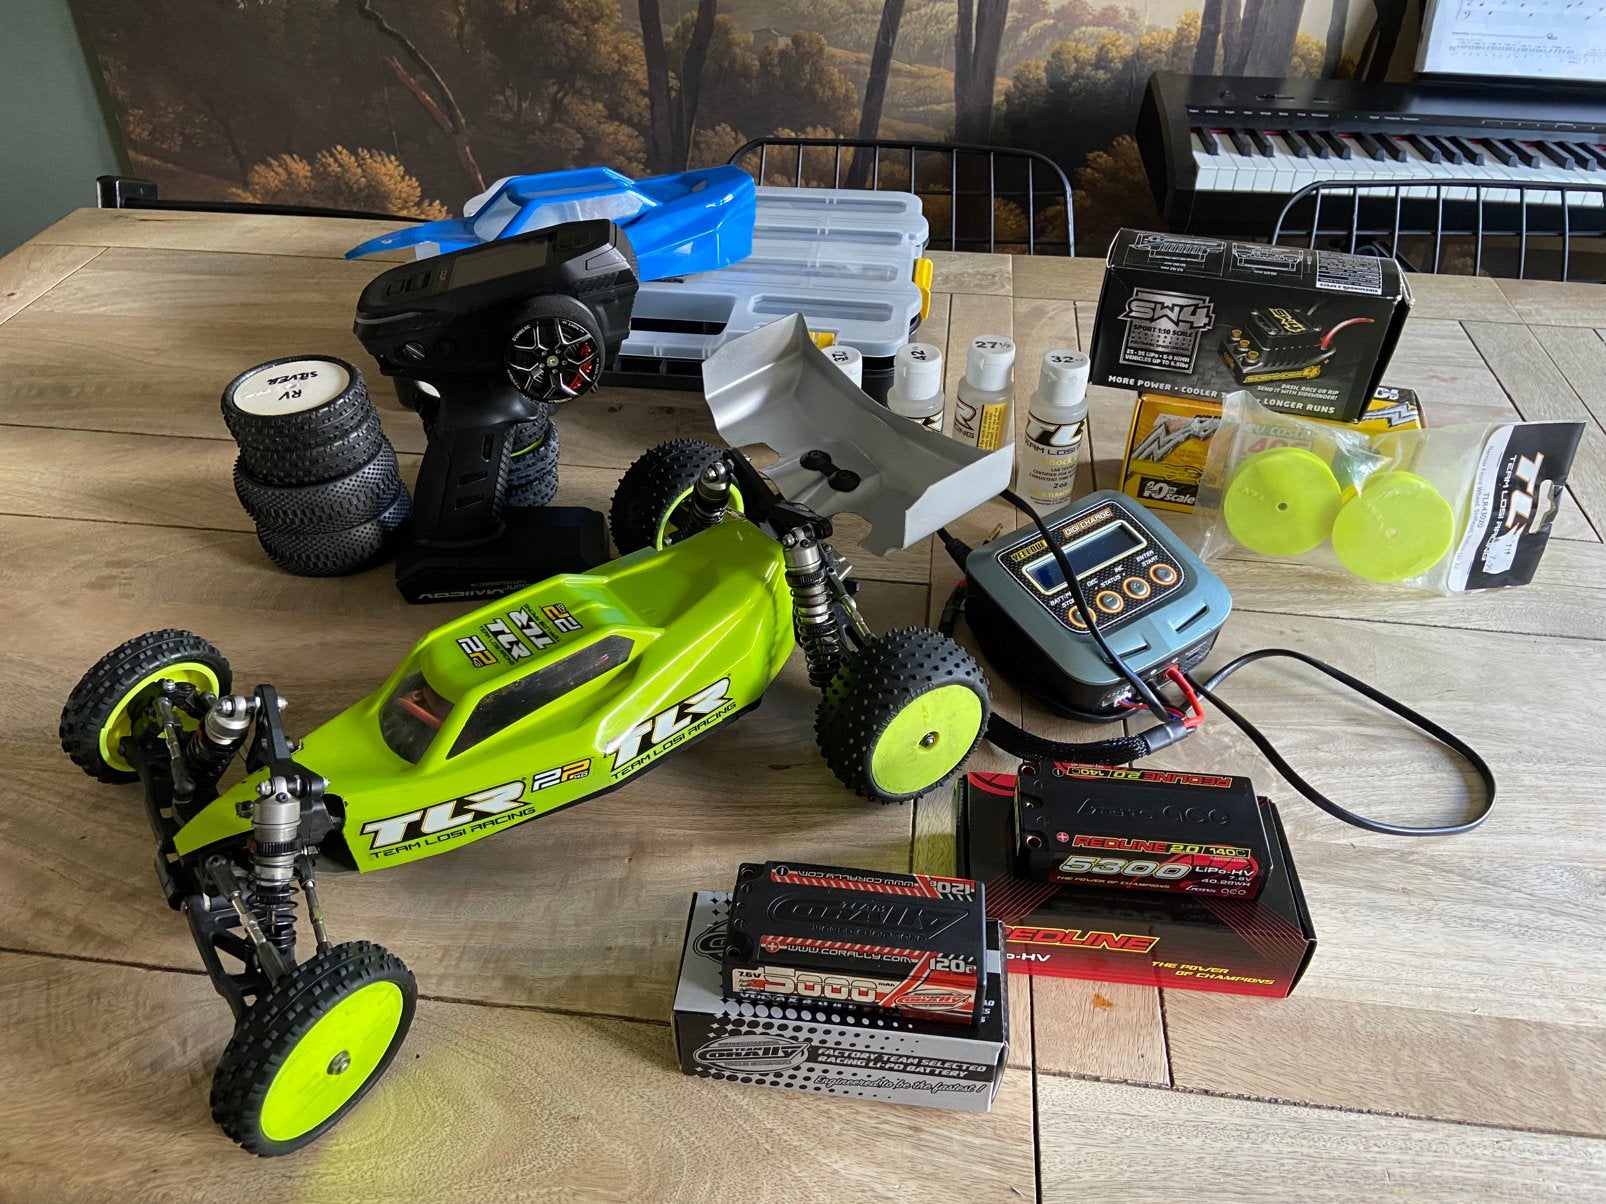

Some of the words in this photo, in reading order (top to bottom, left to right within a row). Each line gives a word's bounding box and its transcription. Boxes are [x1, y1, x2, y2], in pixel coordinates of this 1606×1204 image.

[1125, 298, 1212, 330] SW4
[1133, 324, 1157, 333] SPORT
[1171, 329, 1194, 338] SCALE
[975, 341, 998, 349] 27
[1051, 355, 1075, 363] 32
[1125, 354, 1152, 363] VEHICLES
[1108, 375, 1135, 386] MORE
[1137, 379, 1172, 391] POWER
[1181, 386, 1218, 398] COOLER
[1281, 388, 1297, 396] WITH
[1327, 388, 1340, 396] RIP
[278, 389, 303, 401] RV
[1264, 398, 1303, 410] LONGER
[1306, 403, 1336, 414] RUNS
[1501, 454, 1518, 489] TEAM
[1164, 492, 1196, 505] scale
[1497, 490, 1509, 519] LOSI
[1477, 492, 1490, 529] TLR43020
[1080, 510, 1112, 529] CHARGE
[1136, 550, 1155, 562] ENTER
[1141, 555, 1159, 567] START
[1086, 578, 1099, 587] DEC
[1100, 575, 1122, 588] STATUS
[508, 608, 554, 650] TLR
[484, 618, 533, 662] TLR
[604, 677, 734, 771] TLR
[611, 754, 651, 780] TEAM
[653, 738, 684, 760] LOSI
[687, 701, 737, 736] RACING
[1069, 767, 1107, 778] 140C
[1114, 769, 1143, 780] 2.0
[1144, 771, 1233, 788] REDLINE
[360, 780, 530, 851] TLR
[370, 841, 421, 859] TEAM
[425, 828, 467, 846] LOSI
[470, 806, 537, 834] RACING
[1072, 835, 1169, 853] REDLINE
[1169, 843, 1200, 854] 2.0
[1207, 846, 1250, 858] 140C
[1059, 855, 1193, 880] 5300
[1195, 866, 1255, 877] LiPo-HV
[1074, 877, 1105, 885] POWER
[1120, 881, 1171, 890] CHAMPIONS
[738, 971, 762, 979] 7.6V
[1152, 960, 1178, 970] THE
[1180, 963, 1230, 974] POWER
[763, 966, 878, 1004] 5000
[1174, 969, 1194, 977] OF
[1196, 972, 1275, 985] CHAMPIONS
[817, 1055, 867, 1067] RACING
[867, 1061, 905, 1071] LI-PO
[906, 1065, 969, 1078] BATTERY
[818, 1048, 882, 1060] FACTORY
[882, 1054, 919, 1065] TEAM
[921, 1058, 988, 1073] SELECTED
[814, 1074, 883, 1090] Engineered
[881, 1079, 894, 1089] to
[895, 1078, 911, 1091] be
[912, 1080, 933, 1091] the
[931, 1079, 975, 1094] fastest
